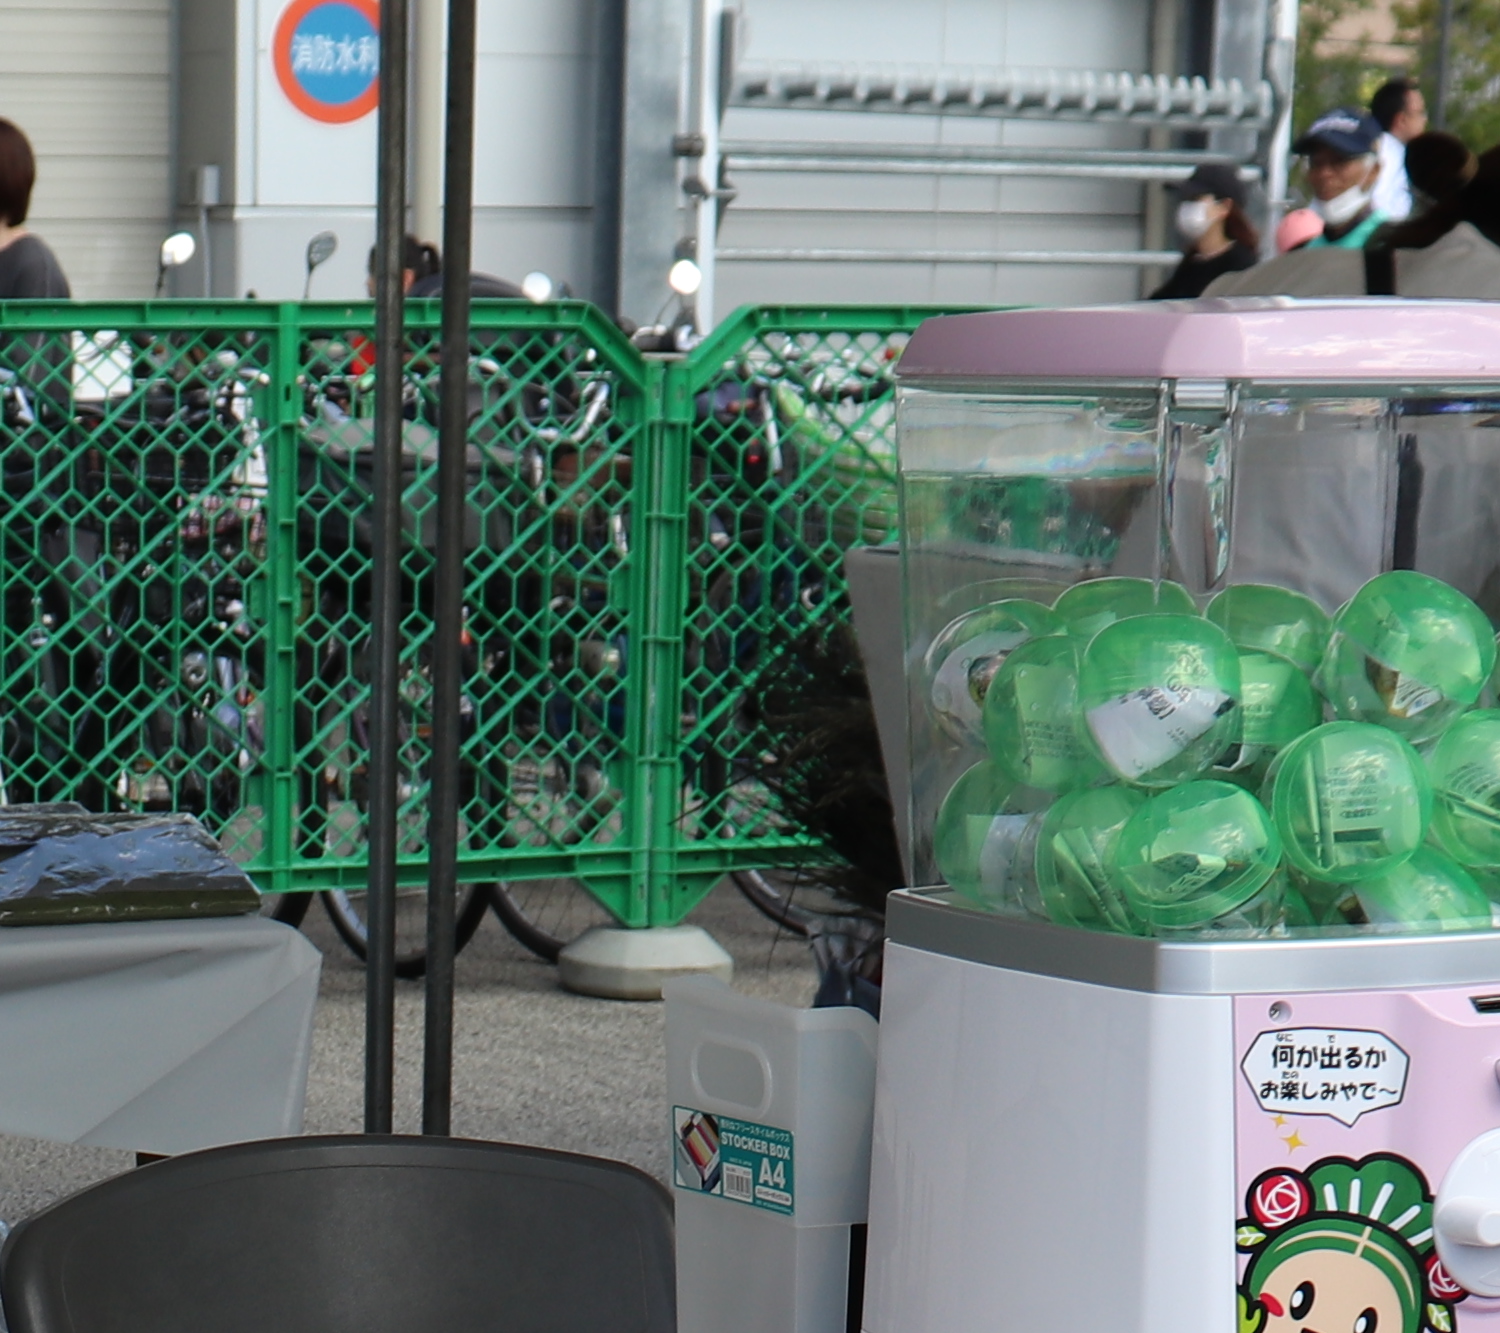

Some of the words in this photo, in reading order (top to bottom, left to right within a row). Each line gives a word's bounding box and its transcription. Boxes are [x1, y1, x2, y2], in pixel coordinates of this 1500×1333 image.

[1271, 1043, 1387, 1070] 何が出るか
[1260, 1080, 1398, 1103] お楽しみやで〜
[721, 1131, 769, 1155] STOCKER
[769, 1143, 791, 1160] BOX
[759, 1157, 786, 1189] A4
